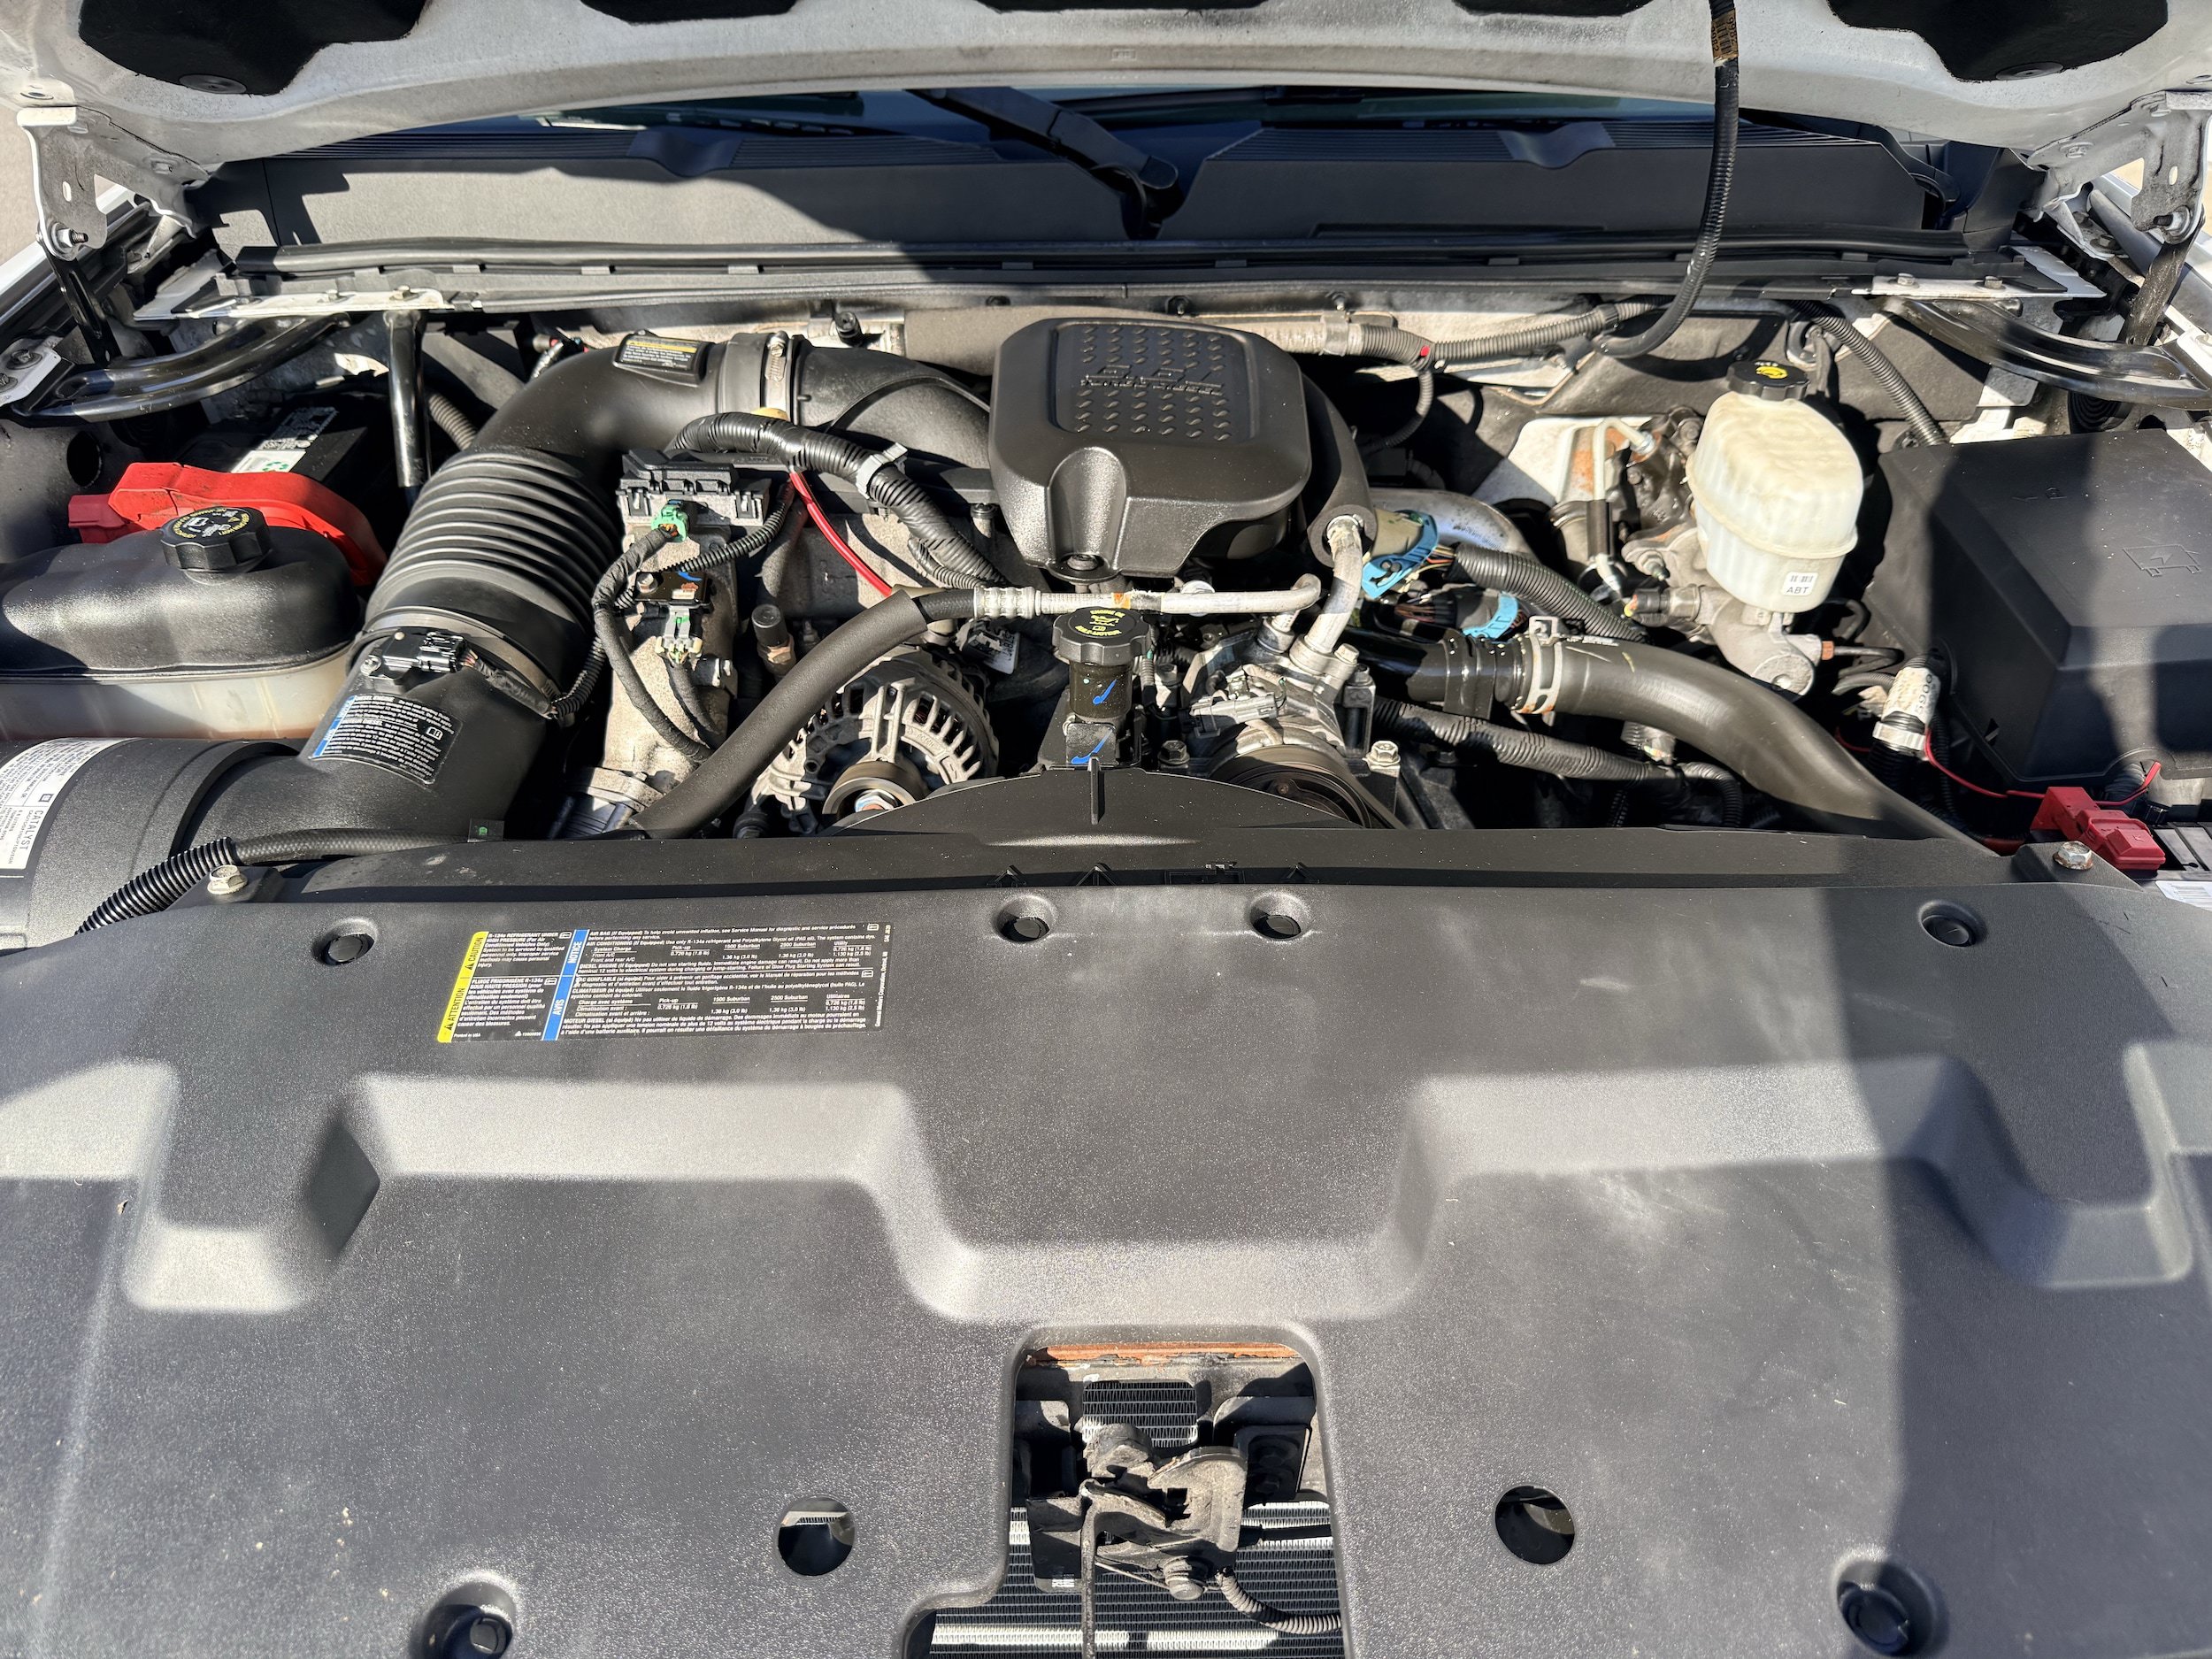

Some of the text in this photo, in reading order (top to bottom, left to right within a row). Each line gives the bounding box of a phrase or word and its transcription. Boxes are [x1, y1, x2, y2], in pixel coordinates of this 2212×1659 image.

[19, 810, 44, 850] CATALYST
[469, 937, 484, 962] CAUTION
[567, 941, 583, 964] NOTICE
[450, 987, 465, 1021] ATTENTION
[553, 999, 565, 1015] AVIS
